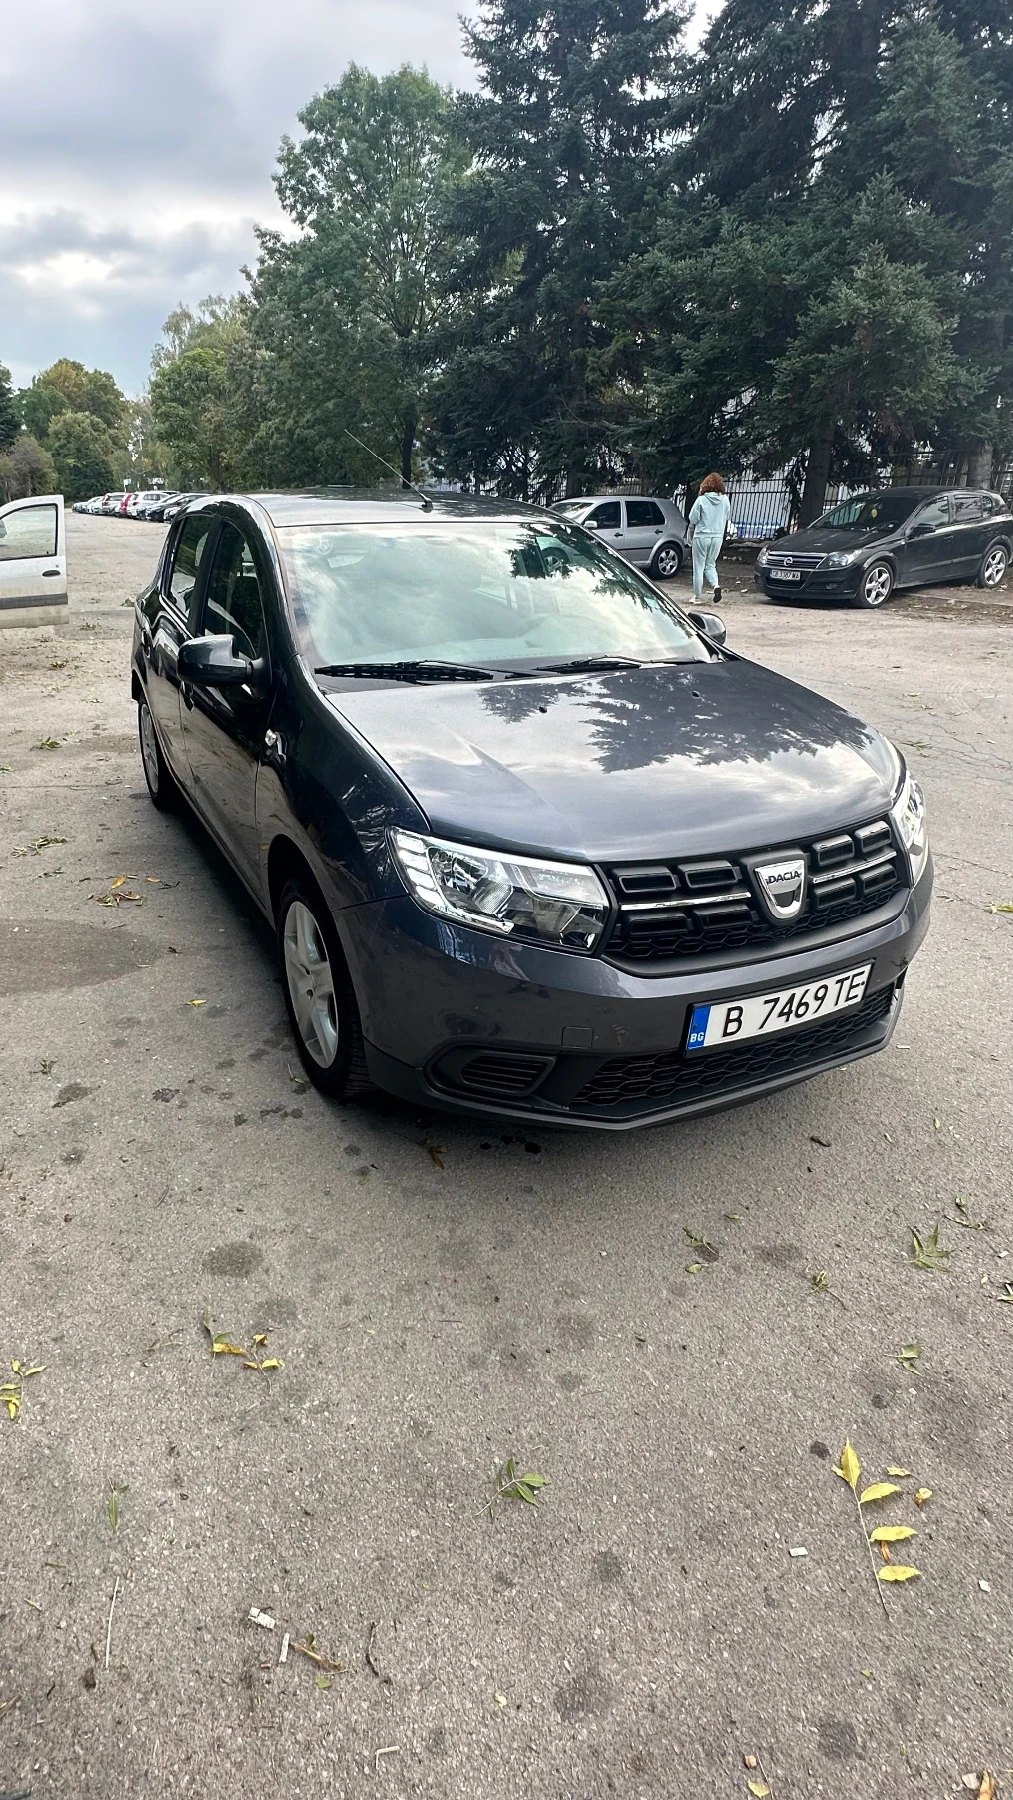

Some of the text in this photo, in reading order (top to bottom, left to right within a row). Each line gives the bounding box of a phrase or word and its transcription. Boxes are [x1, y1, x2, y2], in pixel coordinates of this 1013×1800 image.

[767, 871, 800, 884] DACIA
[722, 970, 866, 1038] B 7469 TE
[689, 1032, 704, 1043] BG
